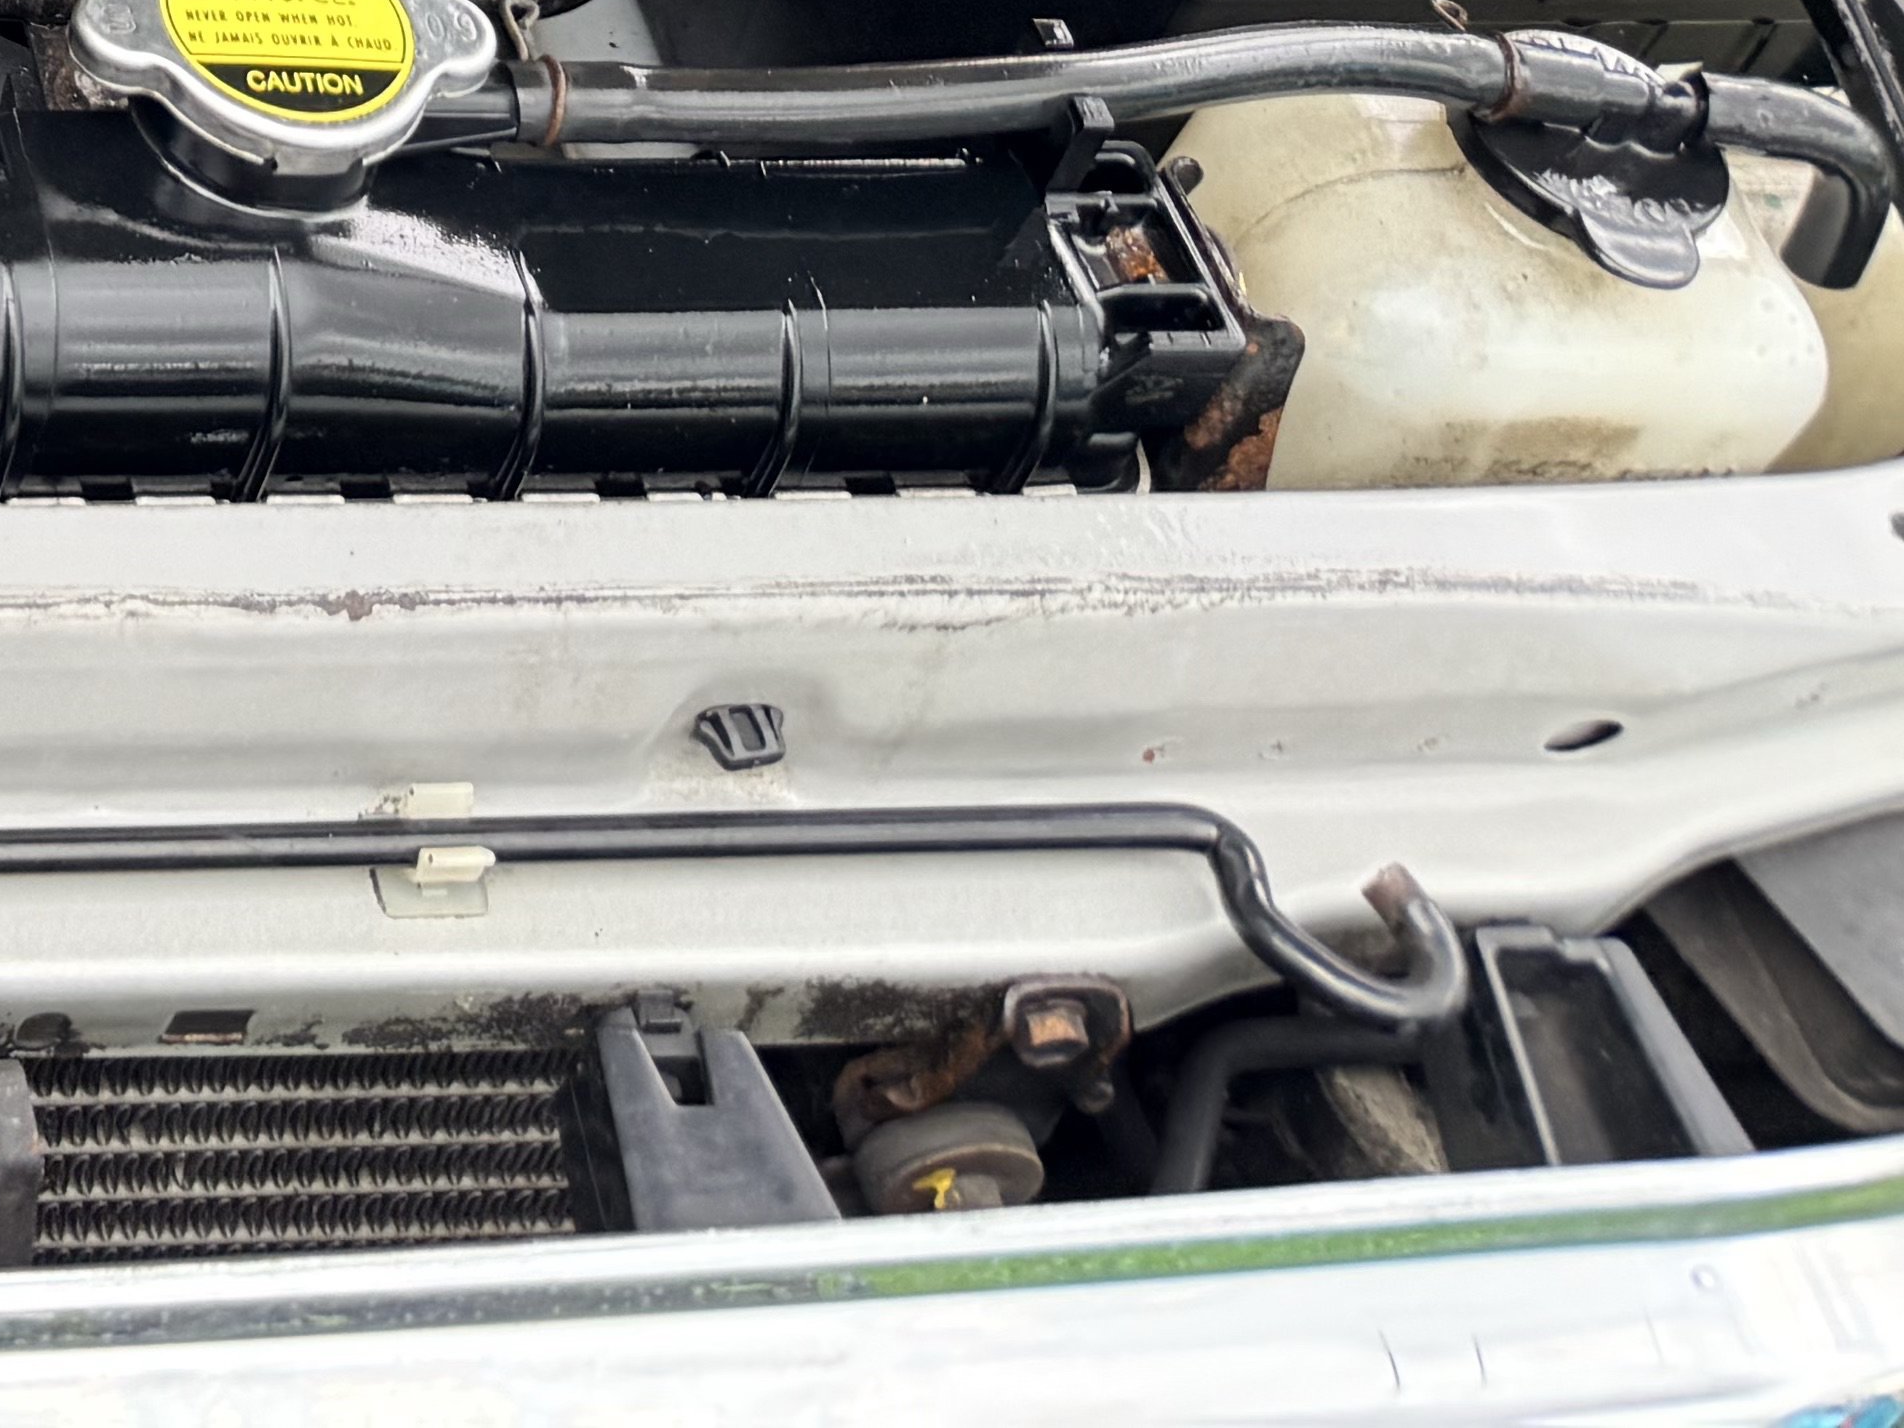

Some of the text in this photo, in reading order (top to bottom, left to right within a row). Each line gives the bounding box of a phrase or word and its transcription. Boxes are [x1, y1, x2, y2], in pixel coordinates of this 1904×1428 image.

[185, 10, 228, 24] NEVER
[234, 10, 272, 26] OPEN
[279, 12, 319, 27] WHEN
[188, 31, 207, 45] NE
[214, 30, 264, 47] JAMAIS
[271, 32, 323, 48] OUVRIR
[245, 69, 365, 97] CAUTION
